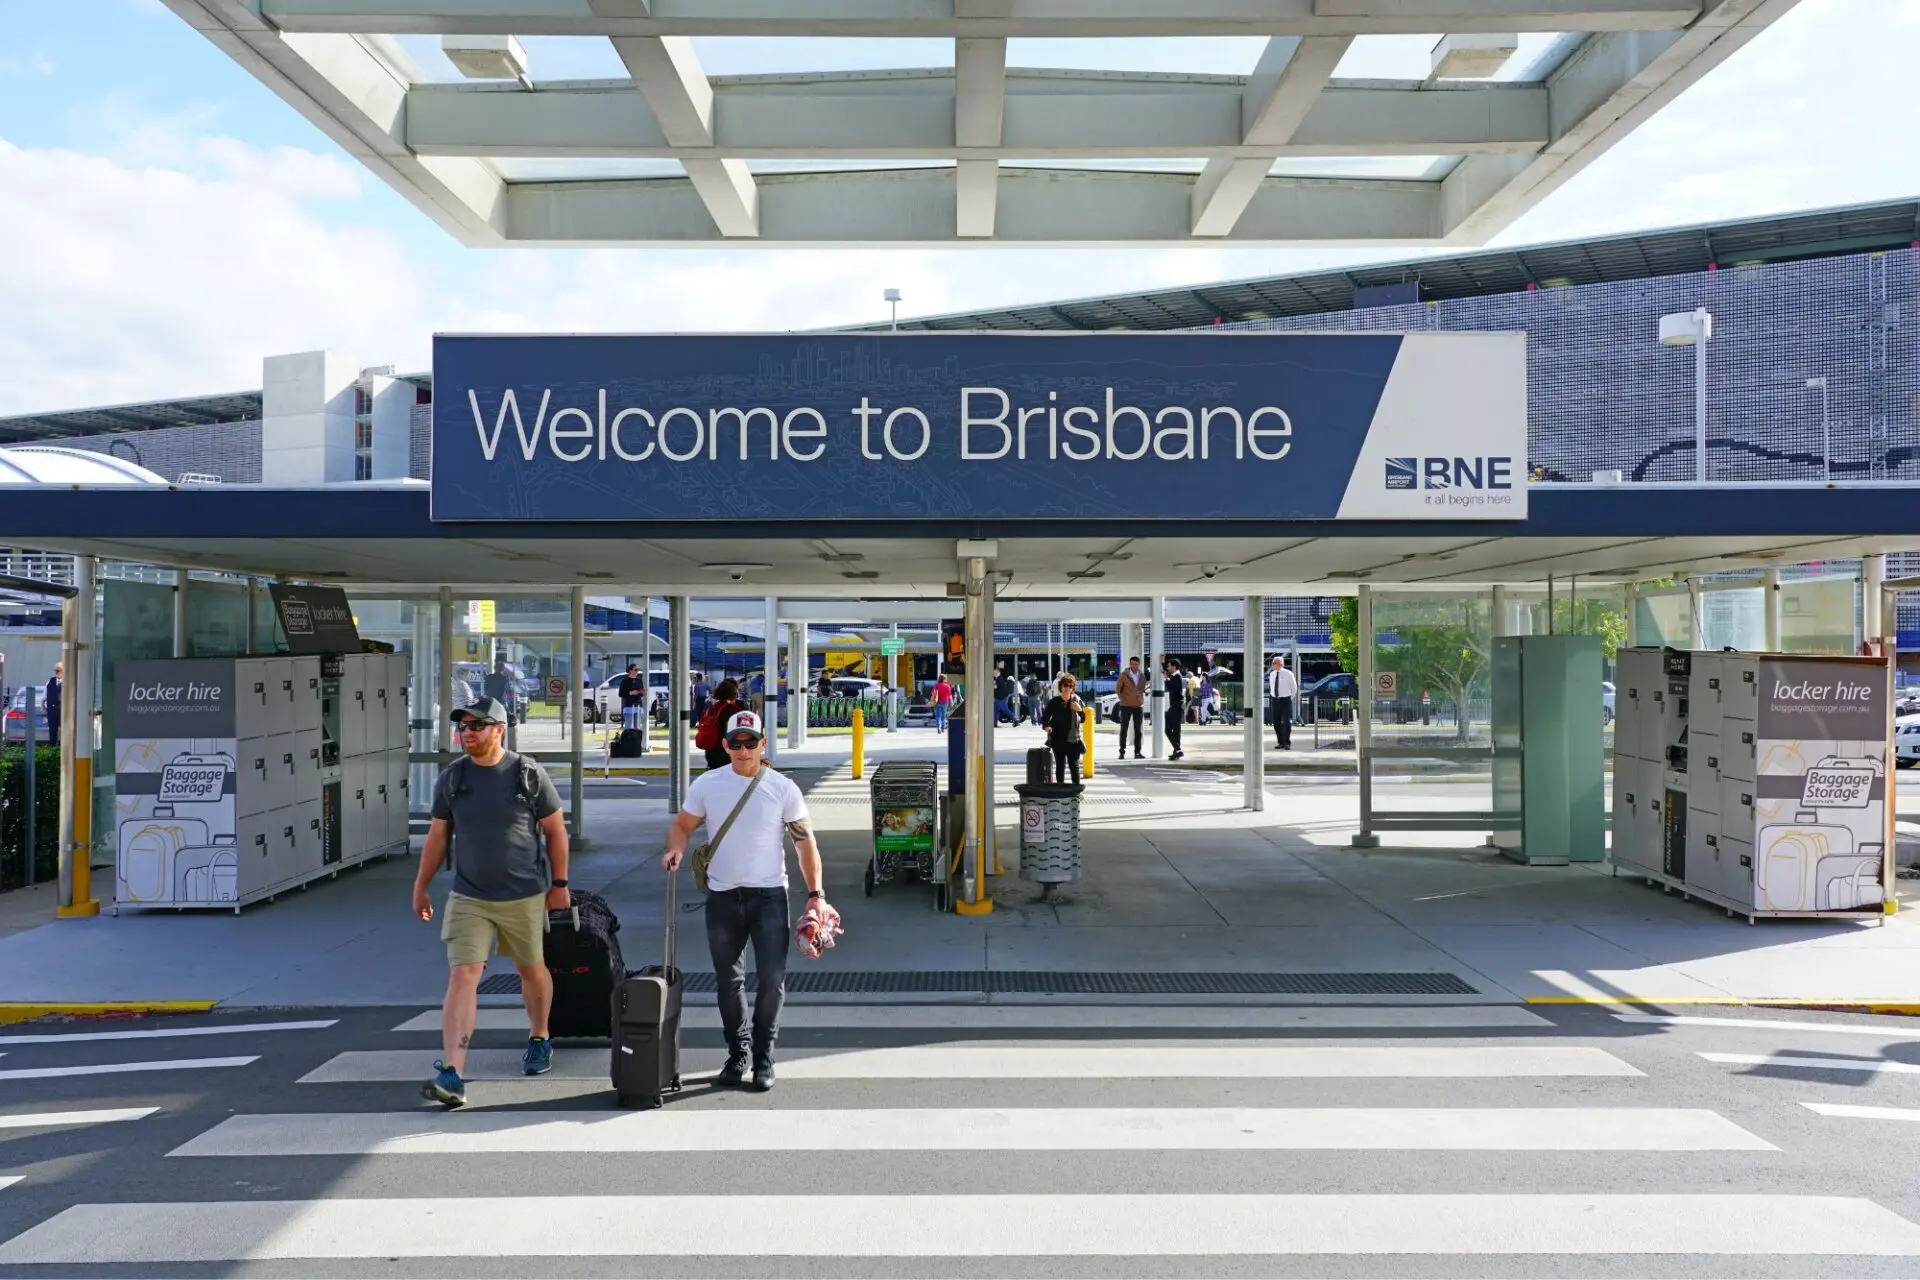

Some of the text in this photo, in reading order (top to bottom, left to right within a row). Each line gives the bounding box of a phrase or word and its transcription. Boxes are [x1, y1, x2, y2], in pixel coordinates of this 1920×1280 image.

[467, 386, 1293, 463] Welcome to Brisbane
[1424, 456, 1511, 490] BNE
[1425, 494, 1511, 507] it all begins here
[129, 681, 221, 701] locker hire
[1773, 680, 1872, 701] locker hire
[1770, 703, 1870, 714] baggagestorage.com.au
[165, 768, 222, 784] Baggage
[1809, 771, 1870, 788] Baggage
[163, 781, 213, 797] Storage
[1806, 785, 1860, 802] Storage
